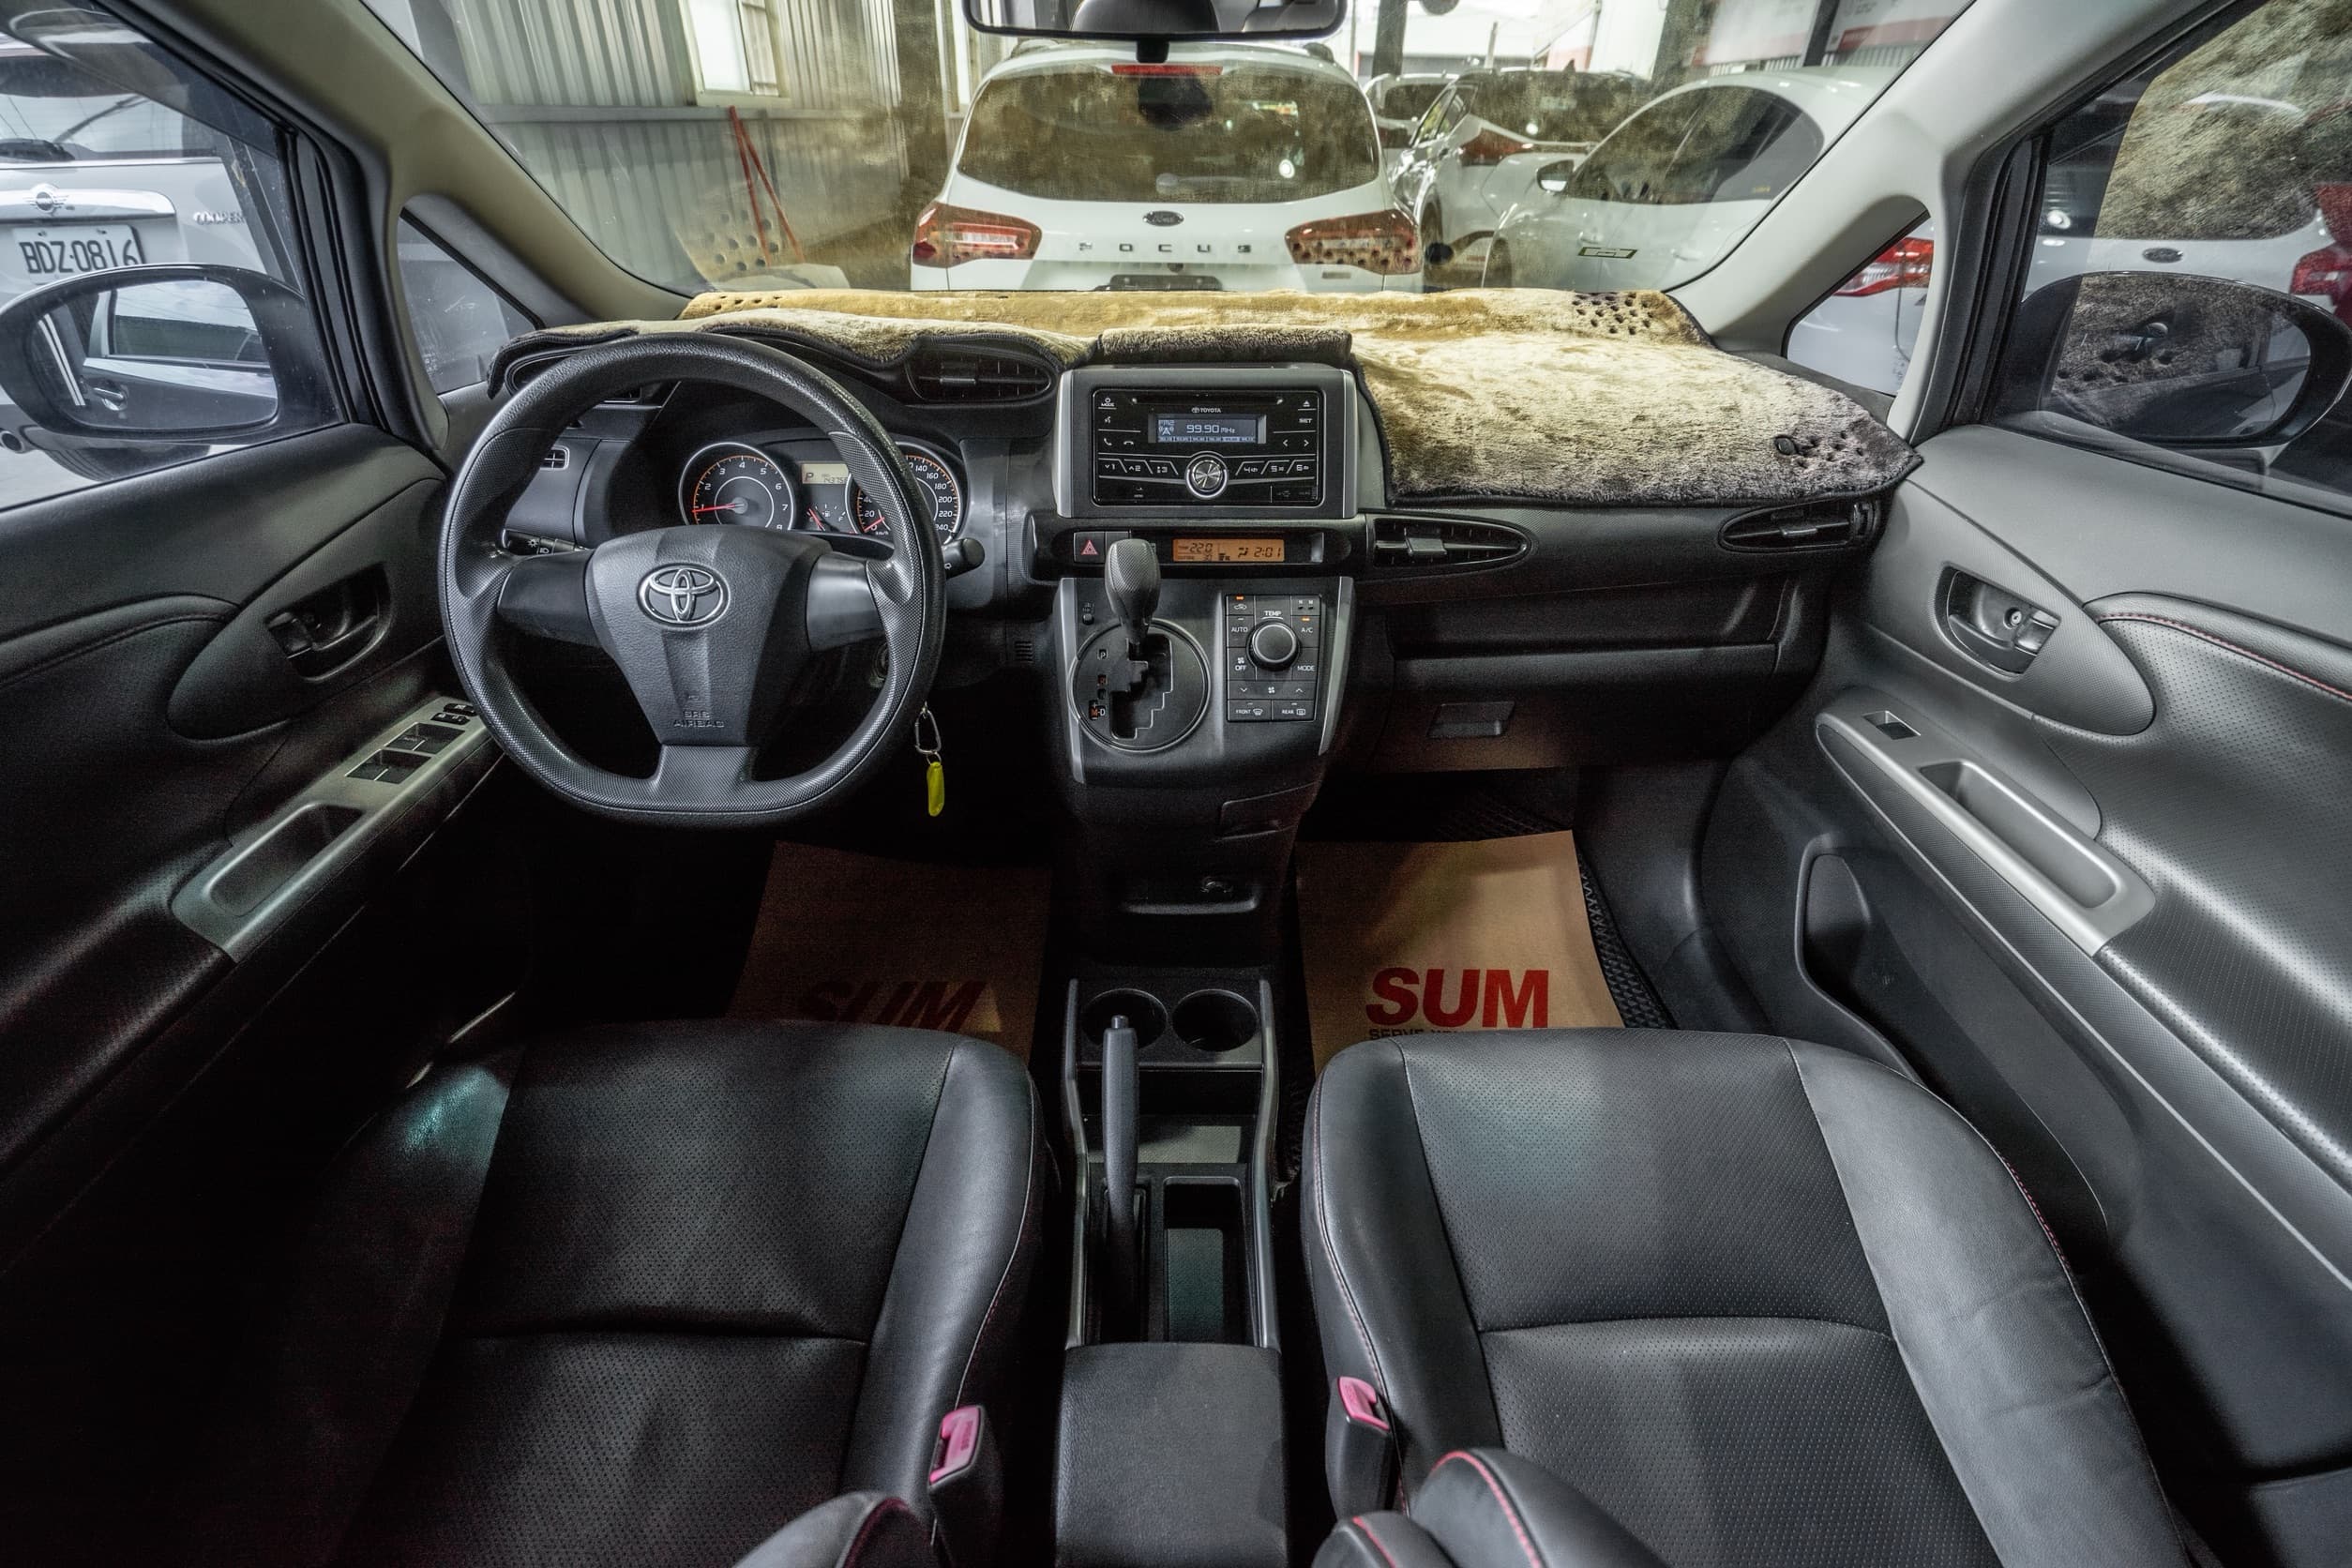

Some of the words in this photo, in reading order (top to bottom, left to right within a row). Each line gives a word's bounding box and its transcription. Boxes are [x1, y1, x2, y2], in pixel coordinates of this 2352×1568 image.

[1186, 424, 1219, 433] 99.90
[806, 472, 814, 481] P
[1254, 547, 1281, 558] 2:01
[673, 719, 725, 728] AIRBAG
[1366, 967, 1549, 1028] SUM
